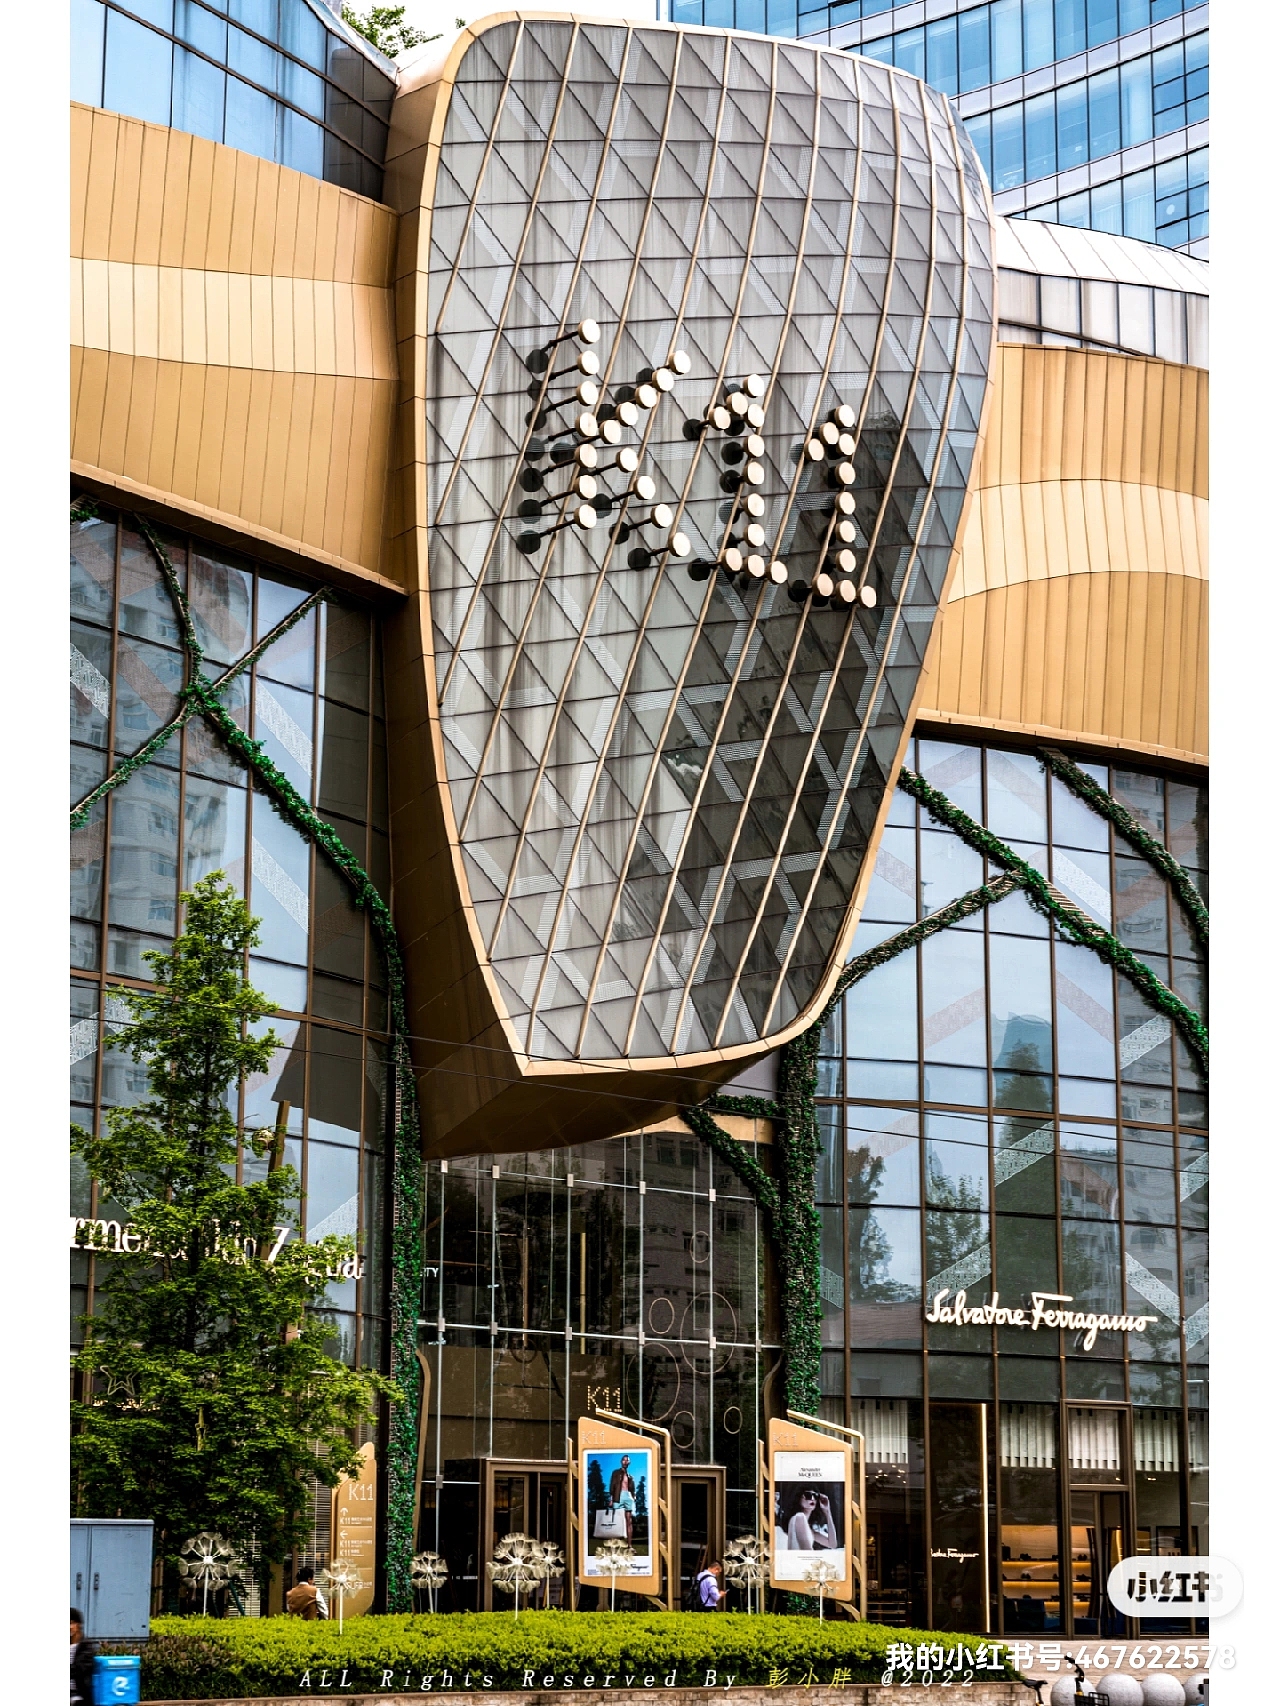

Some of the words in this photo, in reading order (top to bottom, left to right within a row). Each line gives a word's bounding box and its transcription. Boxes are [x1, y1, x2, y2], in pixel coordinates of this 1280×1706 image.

[573, 318, 877, 608] K11
[926, 1288, 1031, 1326] Salvatore
[1030, 1291, 1158, 1351] Ferragamo
[587, 1385, 623, 1412] K11
[581, 1430, 607, 1445] K11
[772, 1432, 799, 1447] K11
[348, 1483, 374, 1501] K11
